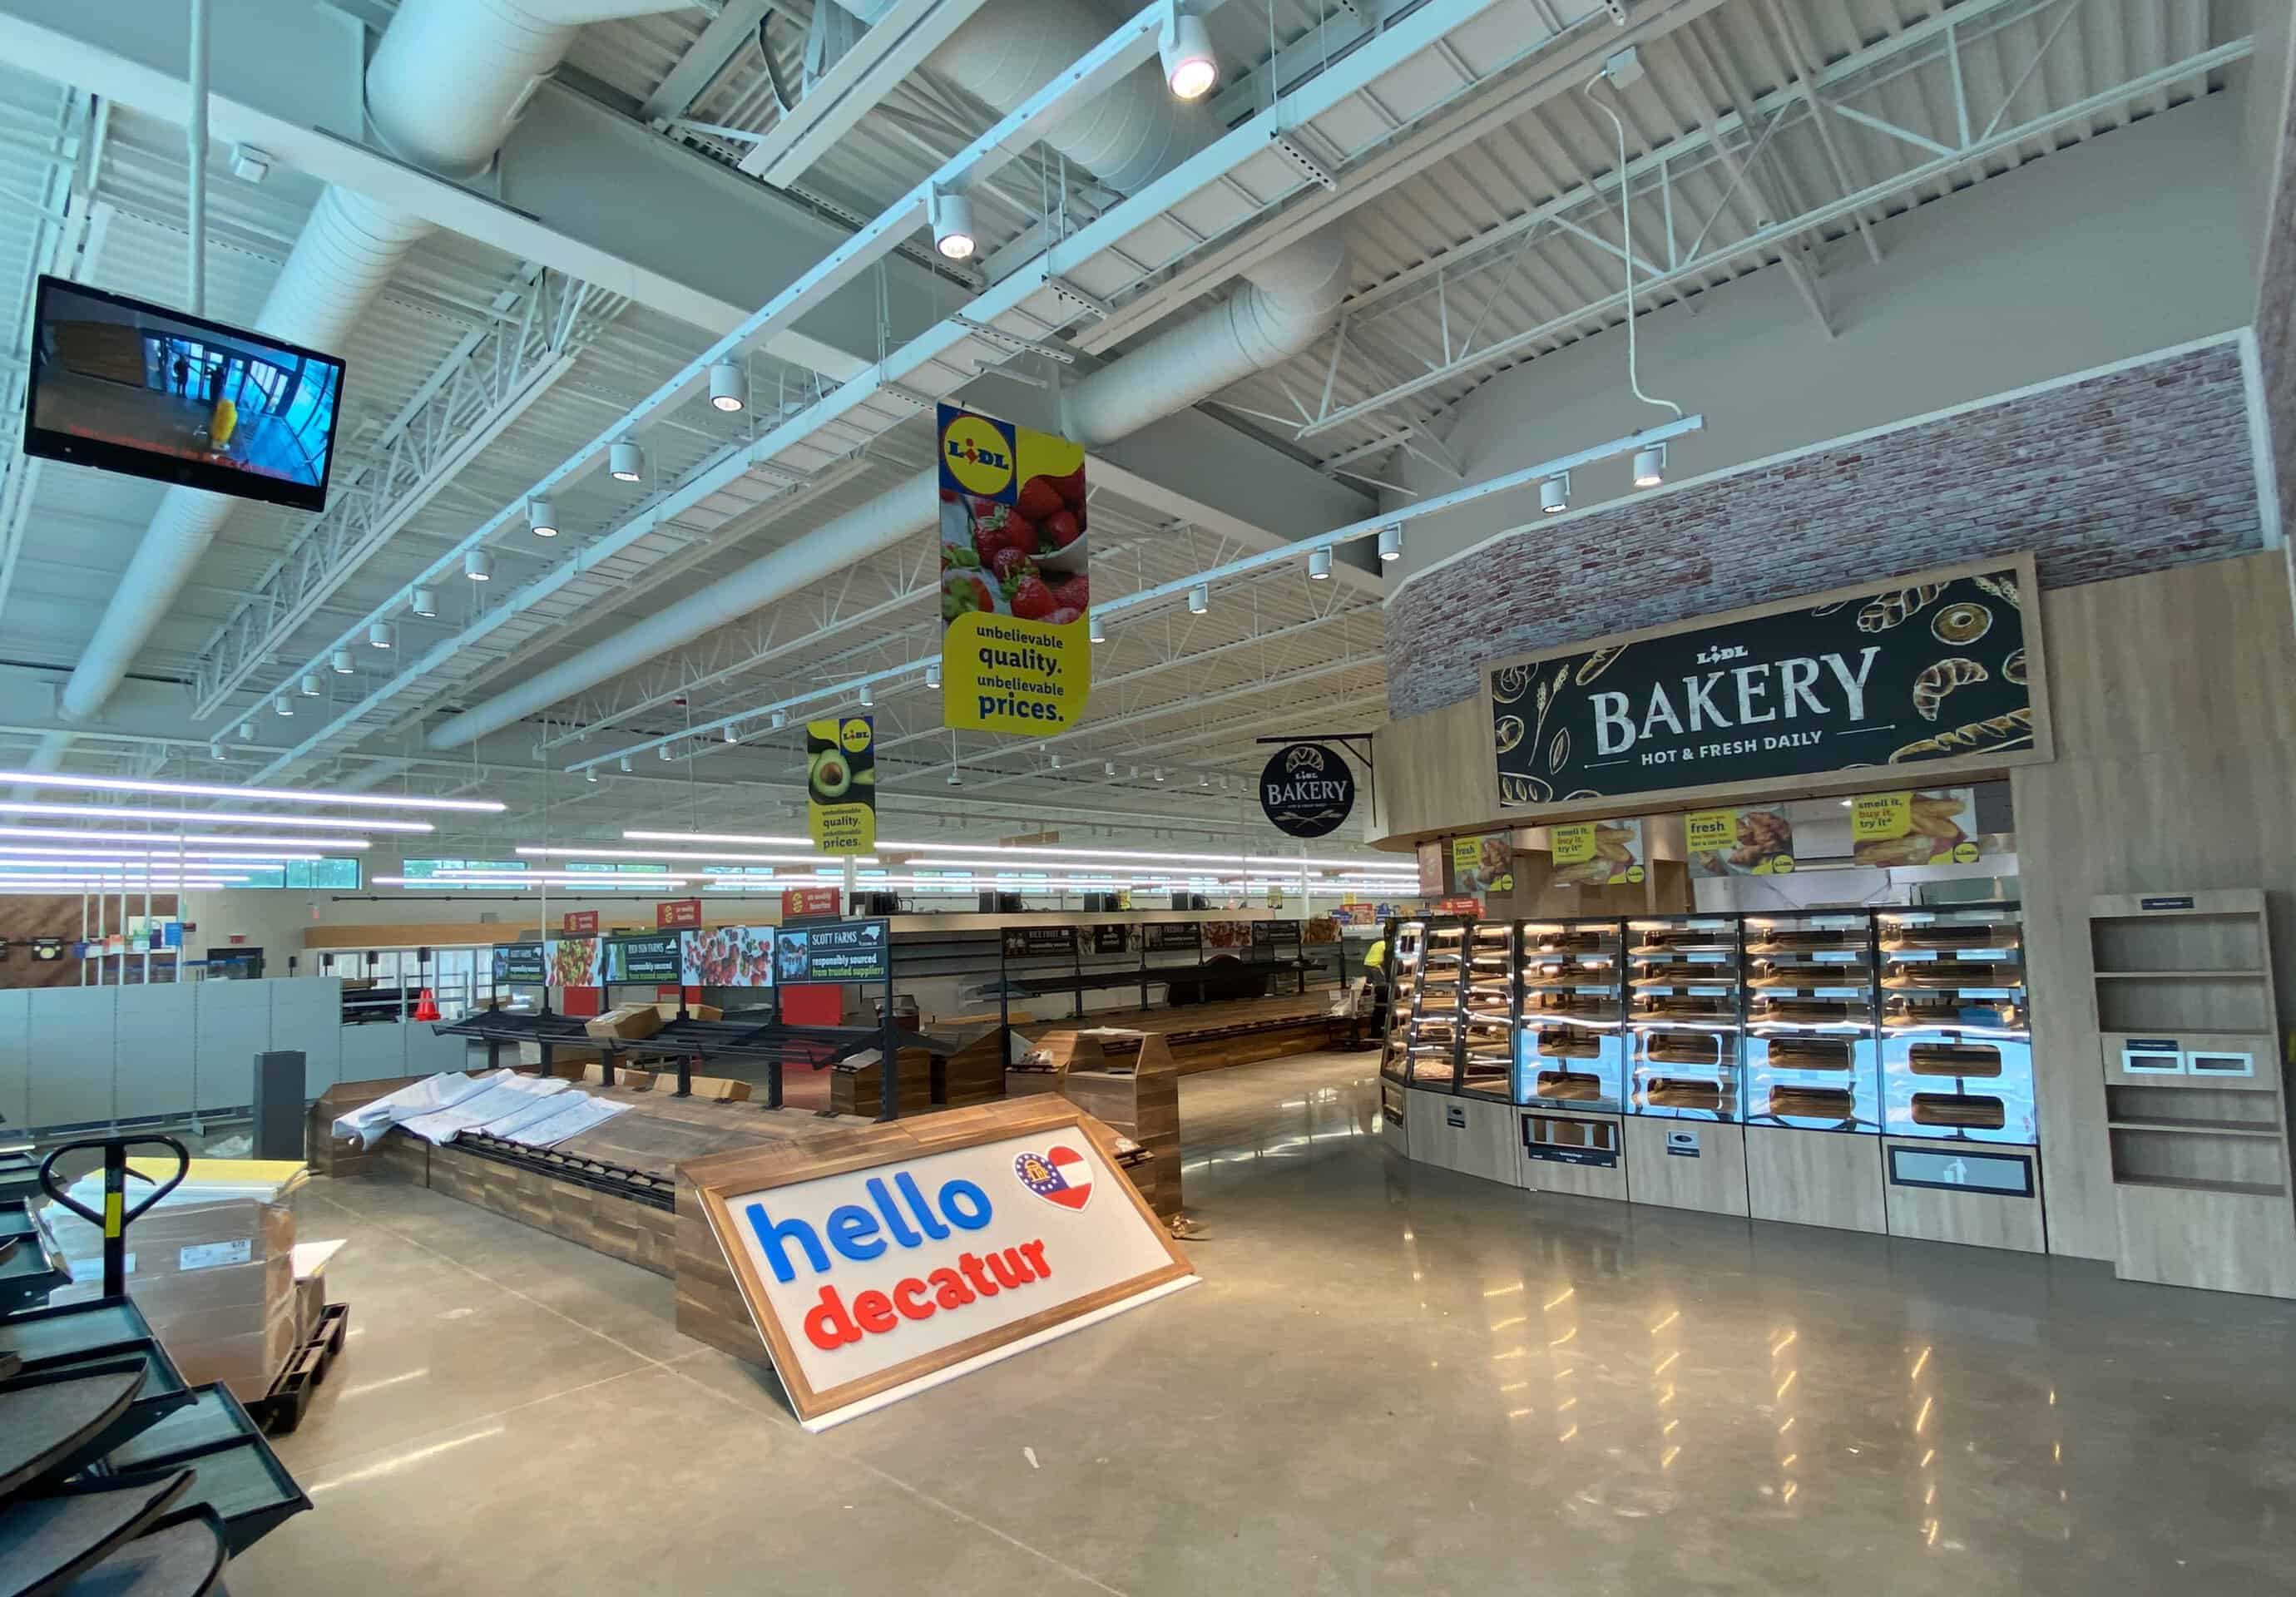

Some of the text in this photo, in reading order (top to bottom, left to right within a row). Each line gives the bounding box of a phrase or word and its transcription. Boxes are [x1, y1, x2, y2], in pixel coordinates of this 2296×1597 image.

[977, 626, 1063, 648] unbelievable
[979, 648, 1061, 677] quality.
[977, 675, 1064, 696] unbelievable
[978, 692, 1065, 722] prices.
[1588, 646, 1882, 755] BAKERY
[1641, 730, 1823, 765] HOT & FRESH DAILY
[1267, 780, 1347, 805] BAKERY
[823, 816, 861, 829] quality.
[1691, 822, 1724, 833] fresh
[823, 837, 861, 852] prices.
[812, 931, 857, 946] SCOTT FARMS
[745, 1170, 992, 1283] hello
[804, 1239, 1052, 1351] decatur
